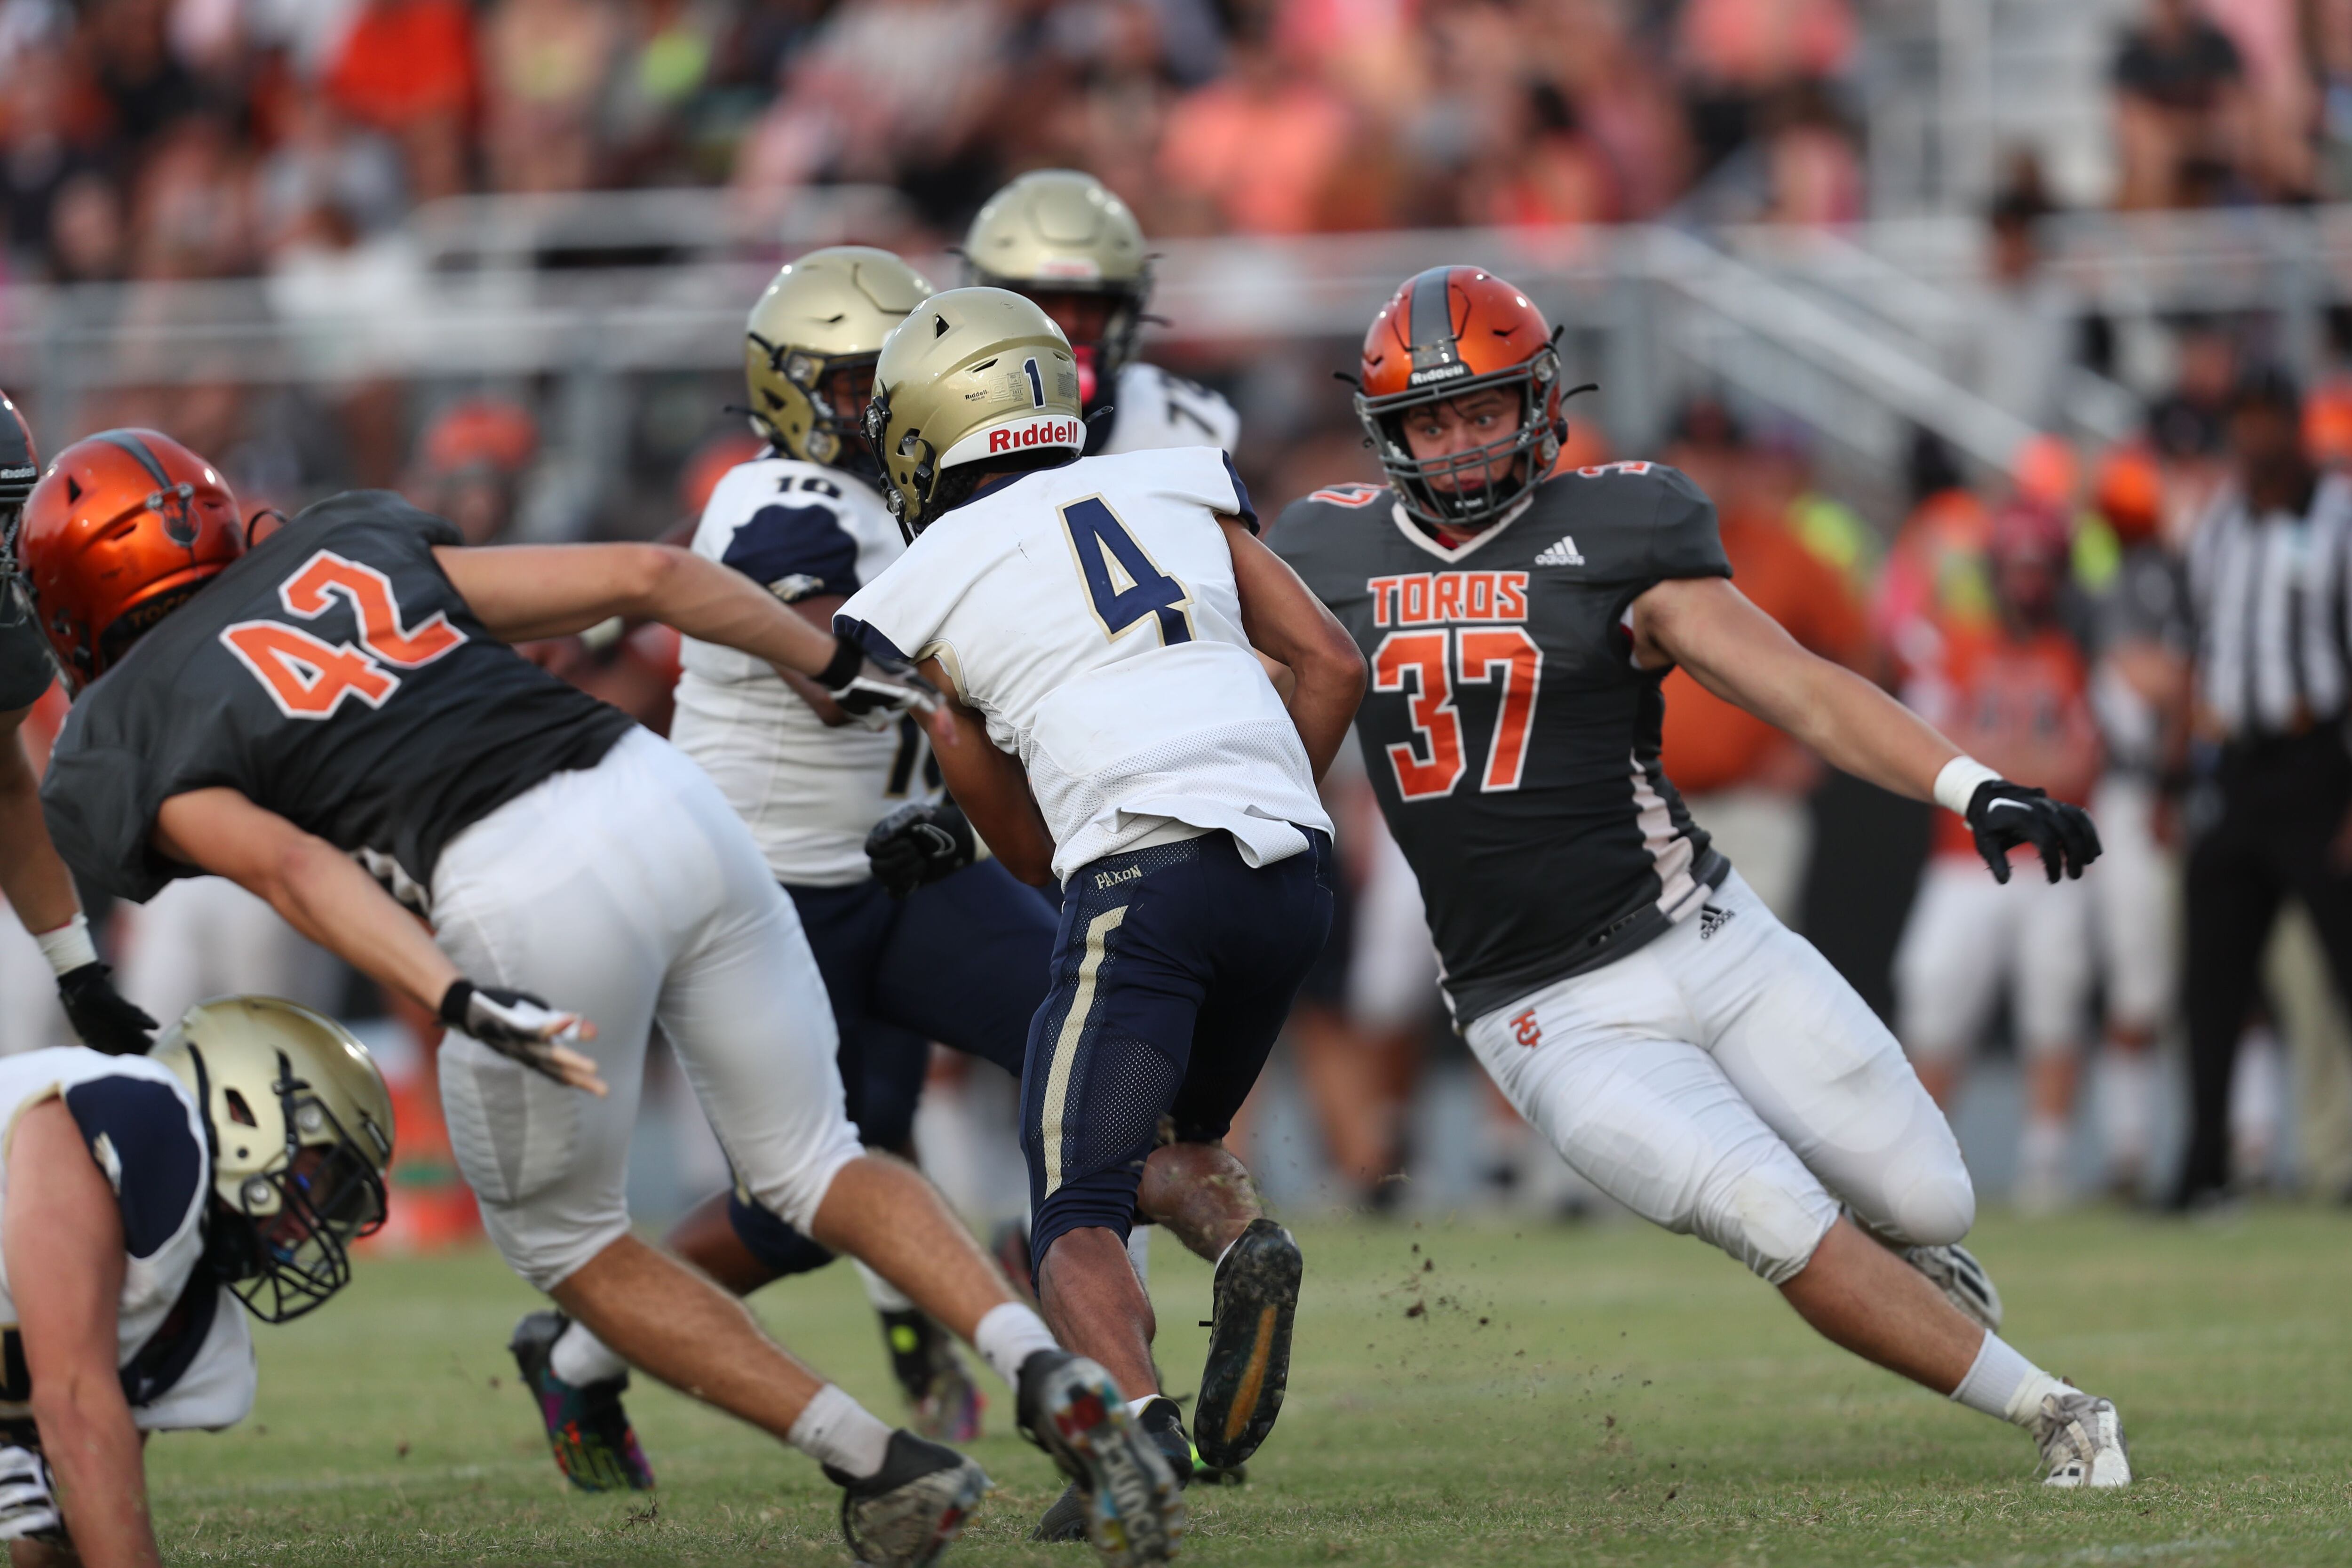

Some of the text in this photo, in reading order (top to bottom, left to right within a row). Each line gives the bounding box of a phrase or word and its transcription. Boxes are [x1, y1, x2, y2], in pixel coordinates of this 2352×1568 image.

[965, 390, 987, 400] Riddell
[1023, 357, 1046, 409] 1
[1411, 365, 1464, 385] Riddell
[989, 421, 1078, 453] Riddell
[1055, 492, 1196, 647] 4
[1534, 554, 1585, 565] adidas
[1367, 571, 1530, 627] TOROS
[218, 549, 469, 720] 42
[1371, 626, 1543, 803] 37
[1095, 864, 1143, 889] PAXON
